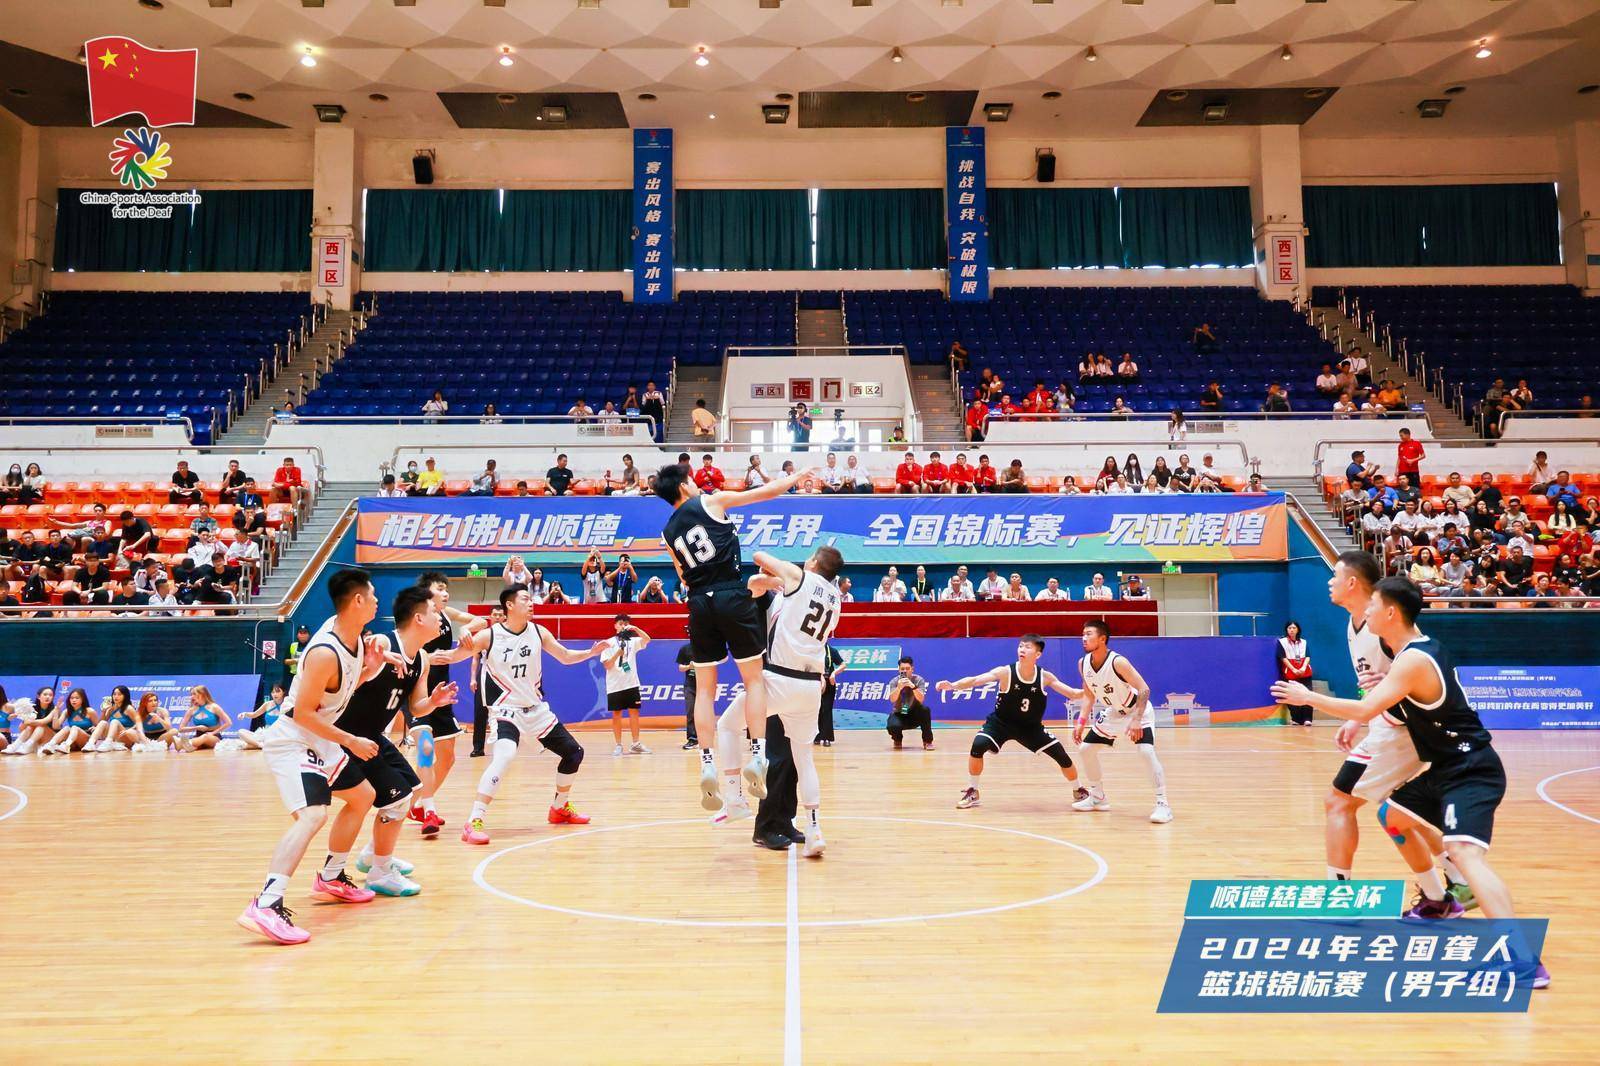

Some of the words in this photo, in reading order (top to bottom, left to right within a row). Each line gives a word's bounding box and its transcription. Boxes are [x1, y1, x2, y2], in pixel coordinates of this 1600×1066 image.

[645, 161, 661, 223] 赛出风格
[958, 160, 975, 221] 挑战自我
[325, 242, 339, 283] 西一区
[645, 233, 661, 296] 赛出水平
[960, 232, 977, 294] 突破极限
[1277, 240, 1292, 280] 西二区
[755, 386, 781, 396] 西区1
[853, 386, 880, 395] 西区2
[674, 524, 716, 568] 13
[800, 600, 833, 641] 21
[503, 645, 531, 662] 广西
[511, 664, 527, 678] 77
[1021, 698, 1030, 712] 3
[1445, 804, 1457, 829] 4
